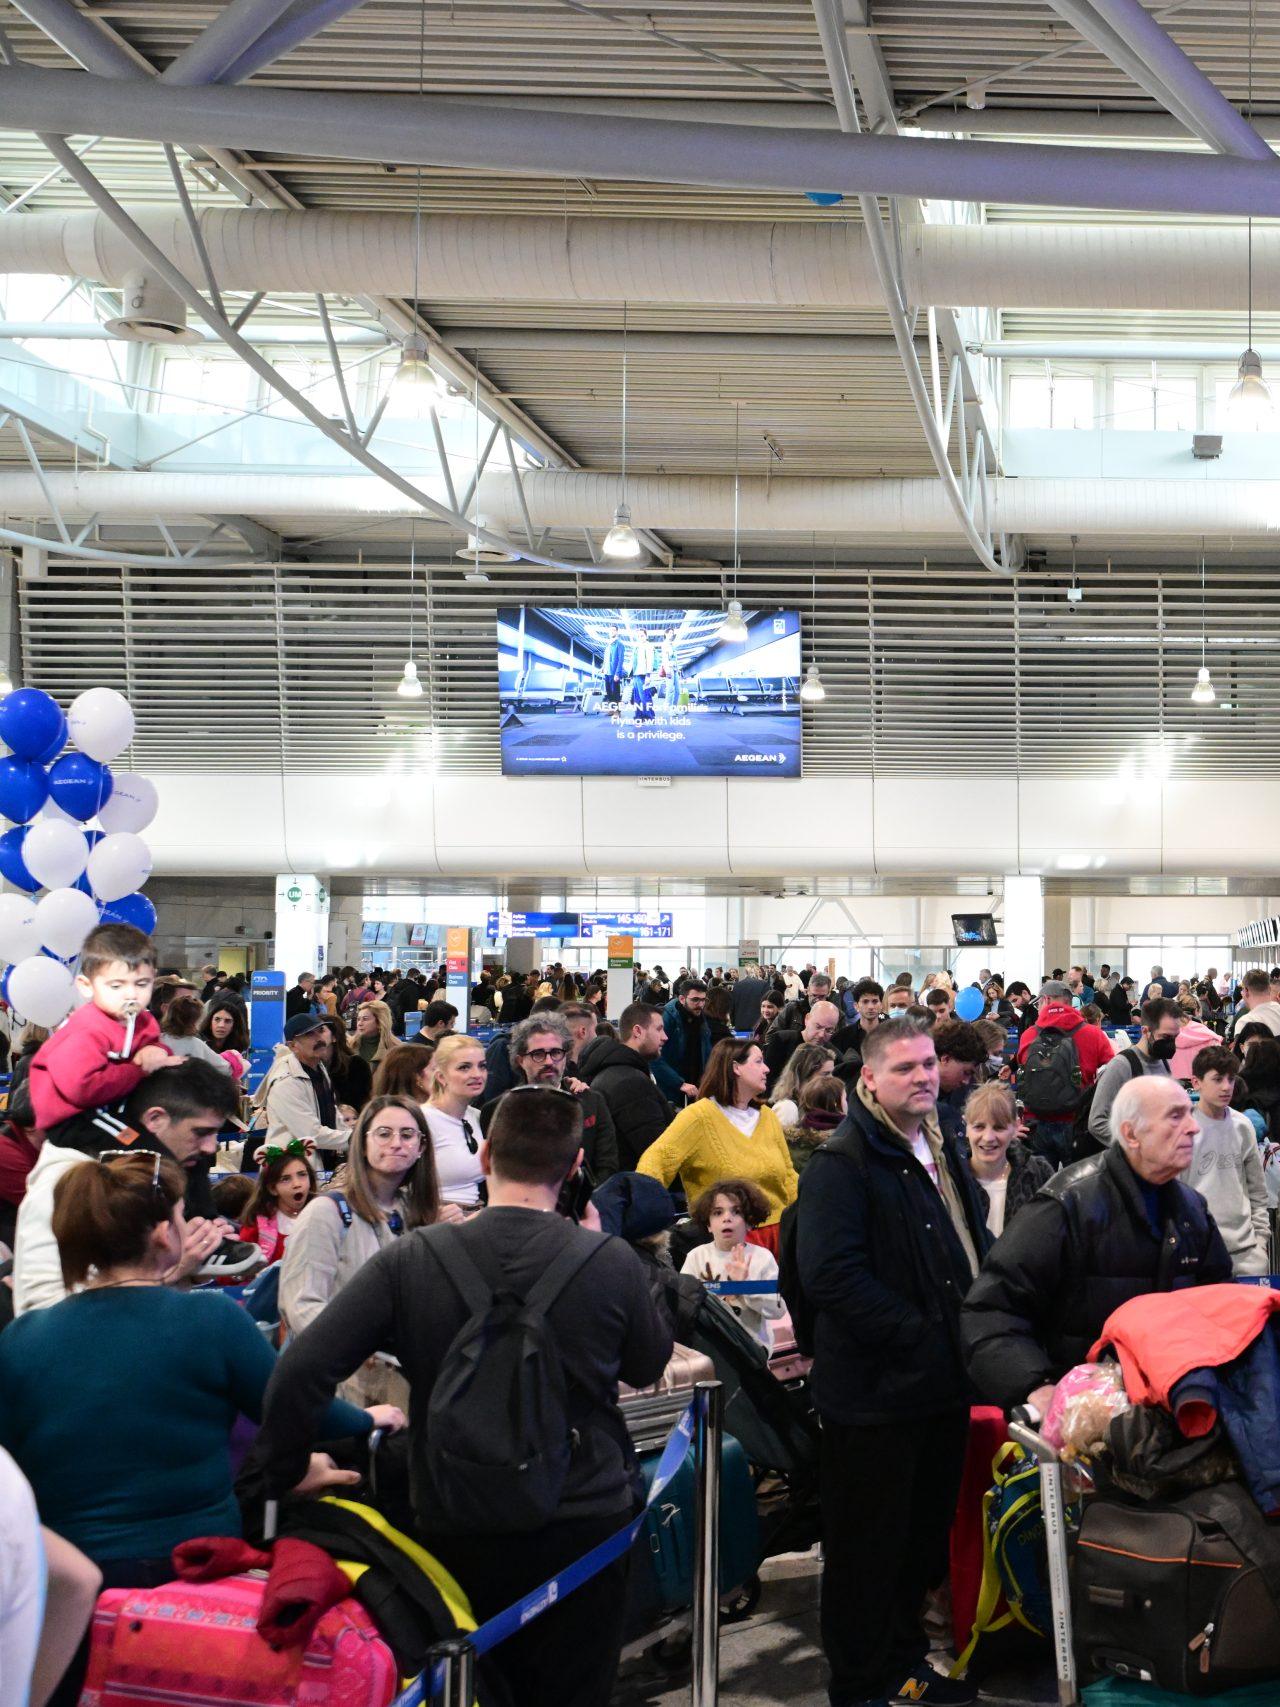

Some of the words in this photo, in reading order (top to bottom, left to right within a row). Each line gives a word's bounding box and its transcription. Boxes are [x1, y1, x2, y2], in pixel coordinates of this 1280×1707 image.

[593, 702, 644, 712] AEGEAN
[610, 716, 643, 728] Flying
[643, 715, 668, 726] with
[669, 715, 692, 726] kids
[616, 730, 626, 740] is
[627, 732, 635, 740] a
[637, 730, 686, 742] privilege.
[734, 754, 777, 763] AEGEAN
[53, 778, 87, 786] AEGEAN
[252, 989, 279, 997] PRIORITY
